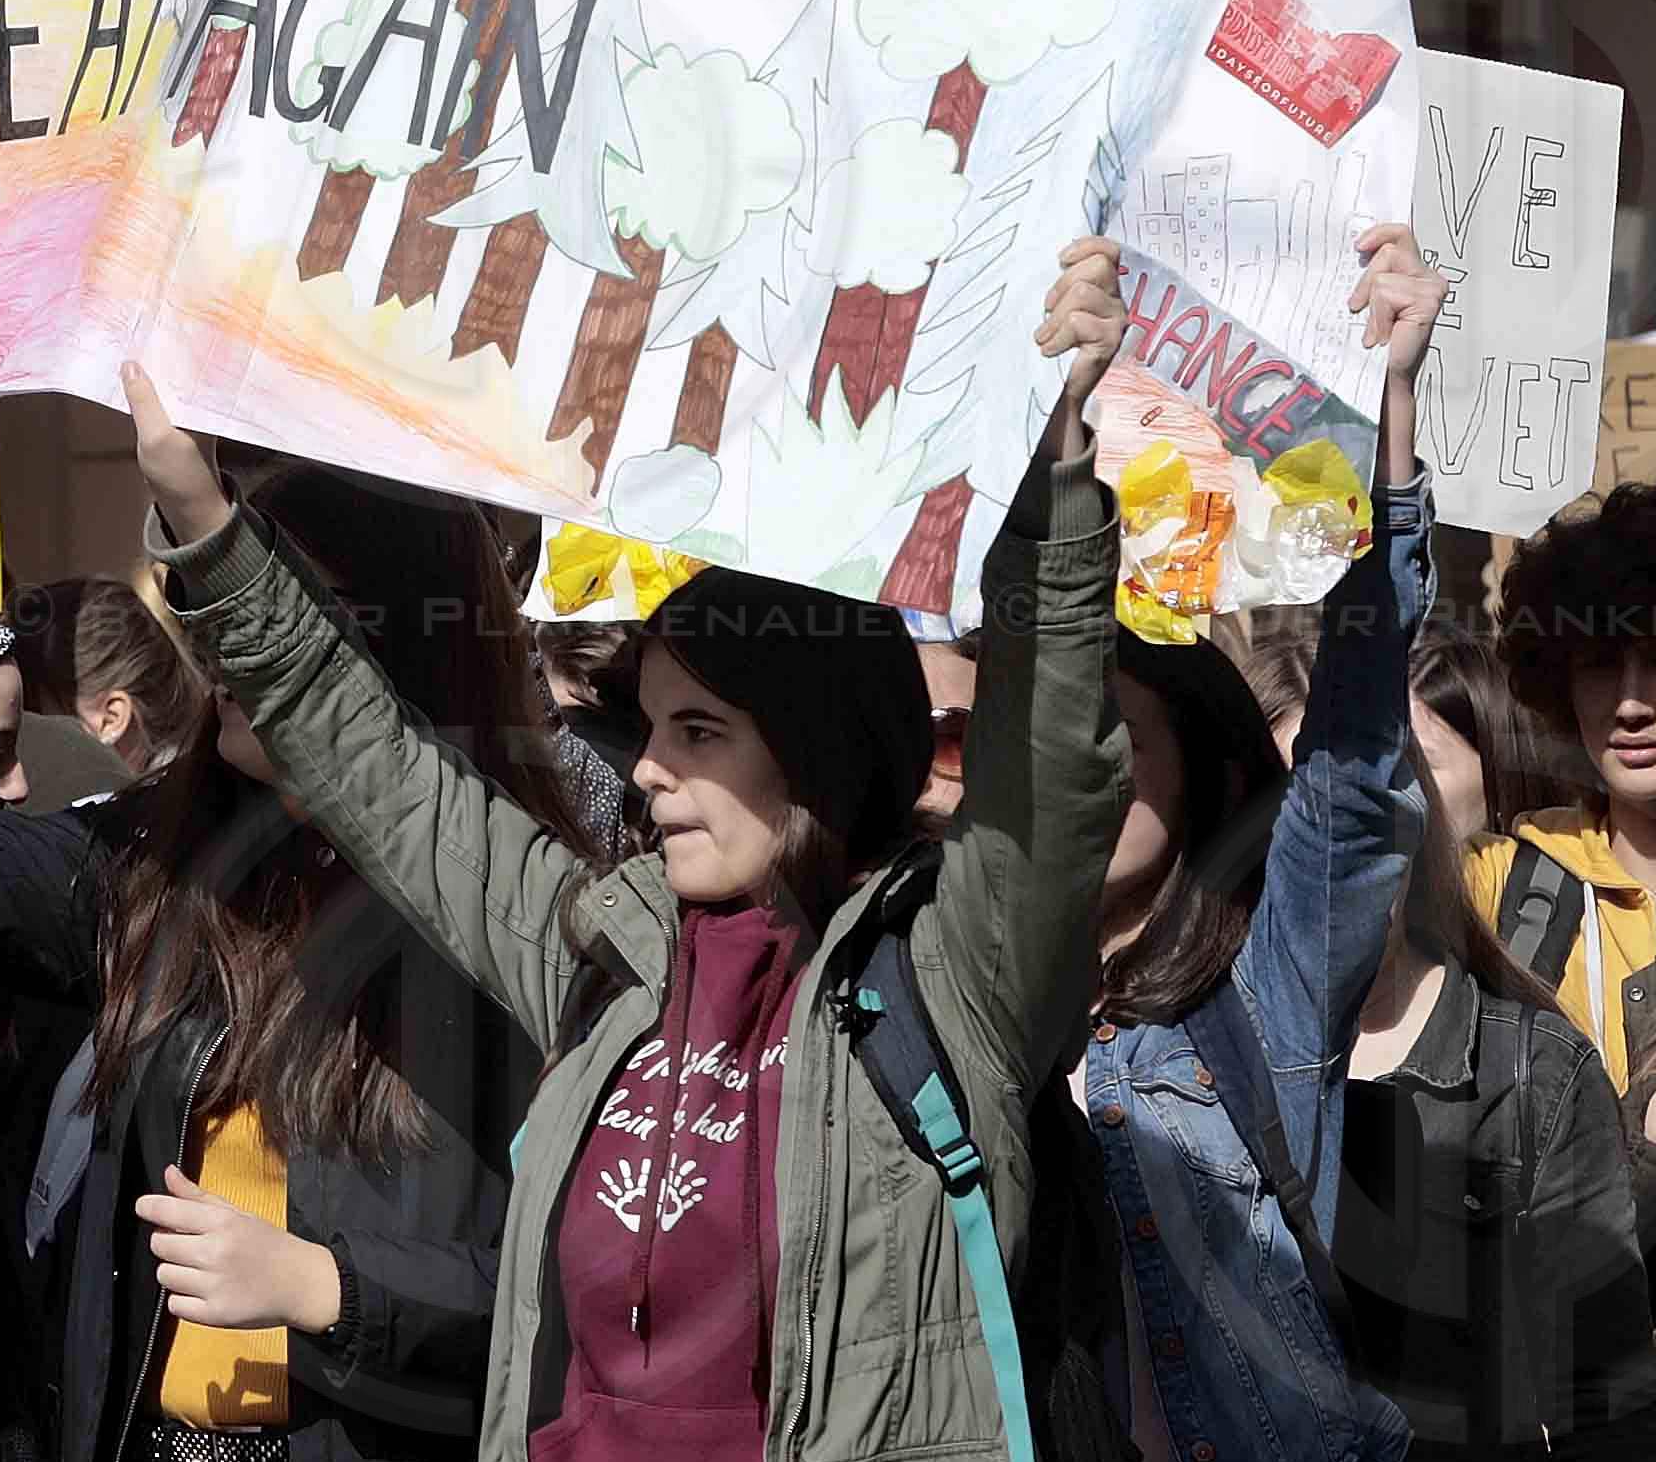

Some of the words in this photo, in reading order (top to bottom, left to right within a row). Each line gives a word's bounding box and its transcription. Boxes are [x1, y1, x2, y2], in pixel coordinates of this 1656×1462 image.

[1208, 42, 1335, 143] IDAYSFORFUTURE
[1428, 104, 1566, 269] VE
[1118, 266, 1325, 459] HANCE
[1414, 344, 1592, 491] NET
